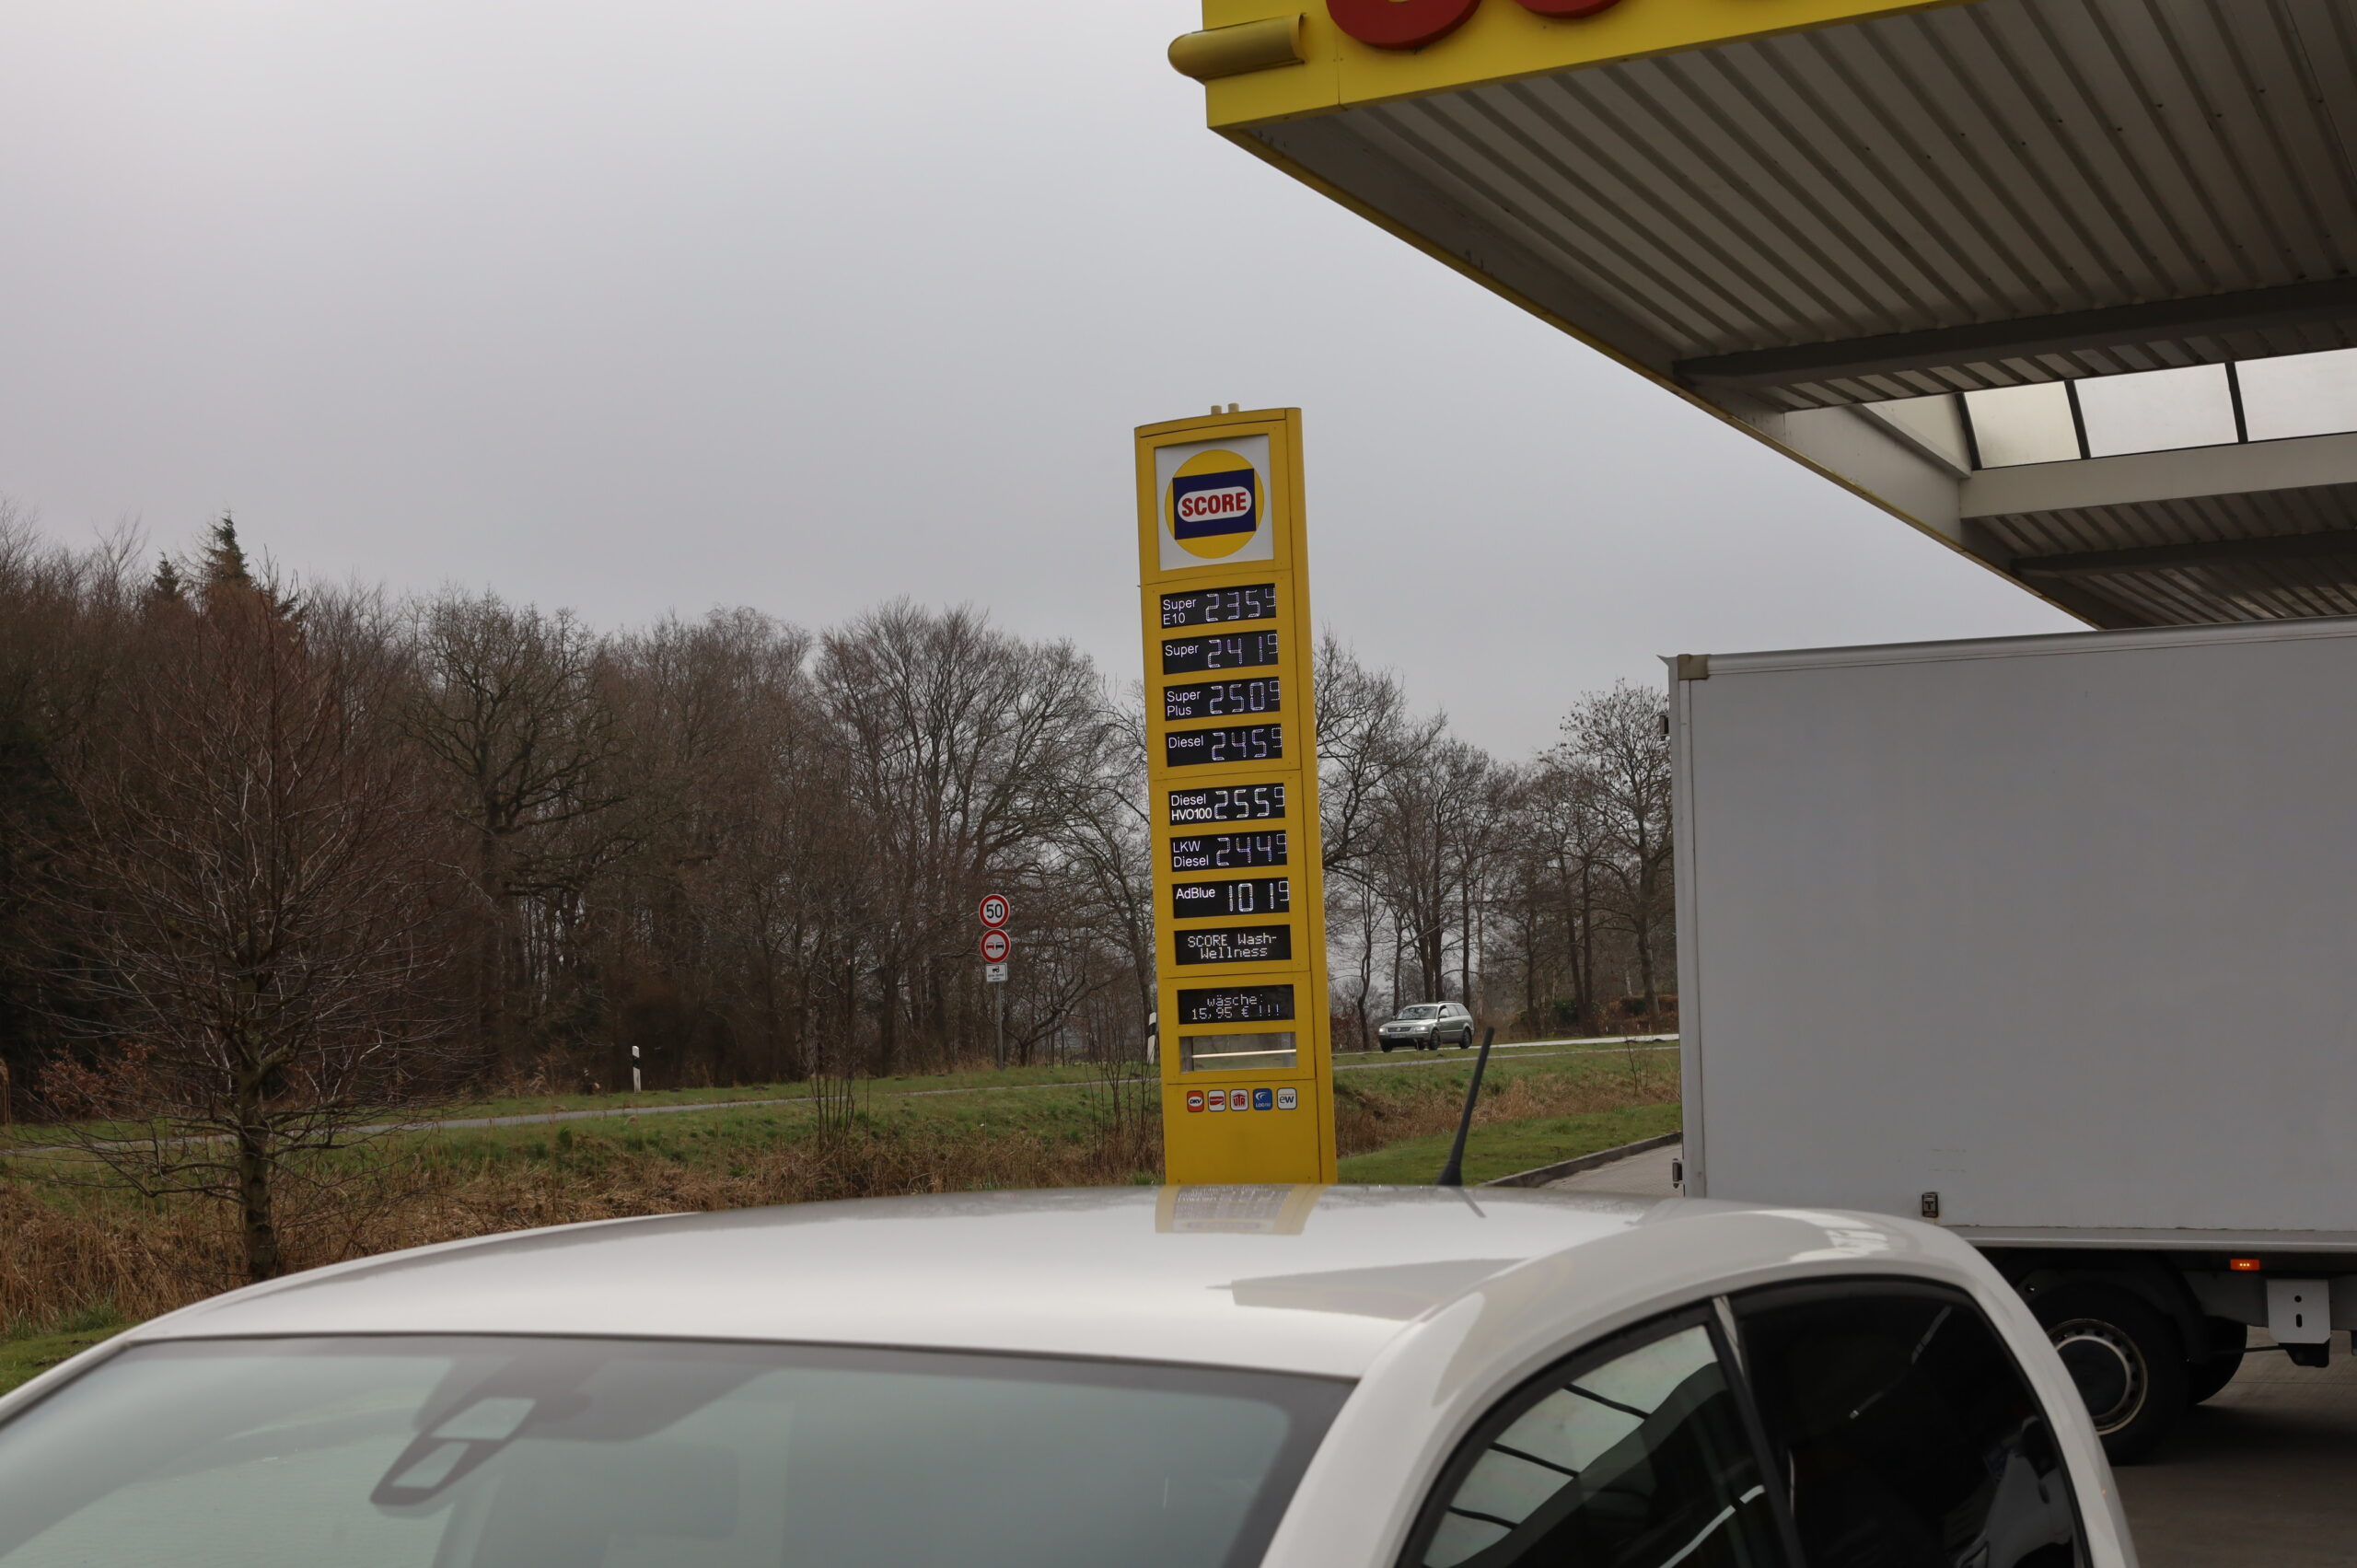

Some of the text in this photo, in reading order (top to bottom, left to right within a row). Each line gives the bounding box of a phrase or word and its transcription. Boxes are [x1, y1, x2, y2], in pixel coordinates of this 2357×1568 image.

[1181, 492, 1247, 517] SCORE
[1163, 598, 1196, 611] Super
[1163, 612, 1186, 625] E10
[1165, 645, 1199, 657] Super
[1167, 691, 1201, 704] Super
[1167, 704, 1191, 716] Plus
[1168, 735, 1203, 749] Diesel
[1171, 793, 1206, 807] Diesel
[1171, 807, 1213, 821] HVO100
[1173, 841, 1201, 854] LKW
[1173, 854, 1209, 868] Diesel
[1176, 887, 1215, 900] AdBlue
[986, 903, 1003, 919] 50
[1188, 932, 1277, 947] SCORE Wash-
[1200, 947, 1268, 959] Wellness
[1191, 1006, 1233, 1020] 15,95
[1241, 1005, 1249, 1017] €
